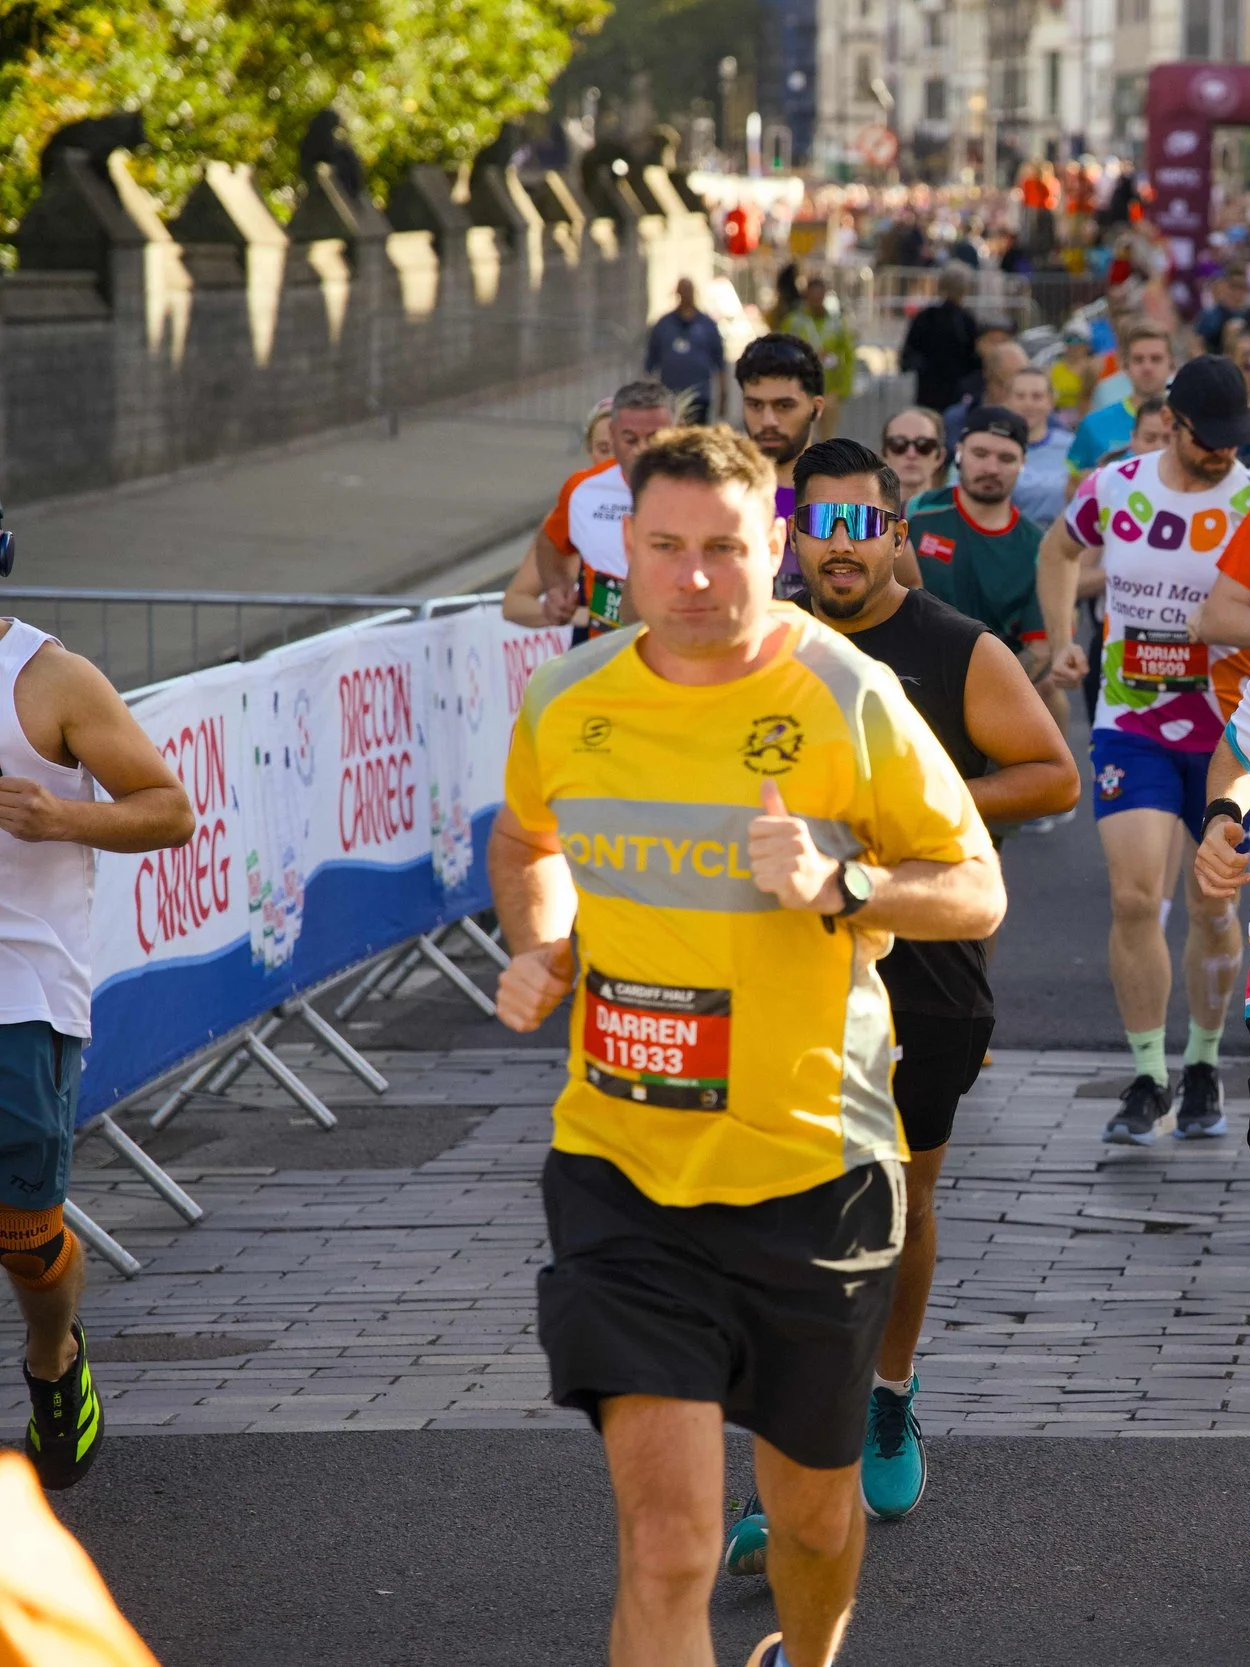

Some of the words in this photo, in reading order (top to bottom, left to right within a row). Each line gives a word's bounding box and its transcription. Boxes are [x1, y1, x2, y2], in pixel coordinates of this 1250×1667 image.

[1136, 645, 1191, 661] ADRIAN
[1140, 660, 1186, 676] 18509
[338, 663, 413, 761] BRECON
[338, 749, 416, 853] CARREG
[596, 1004, 698, 1046] DARREN
[603, 1036, 684, 1074] 11933
